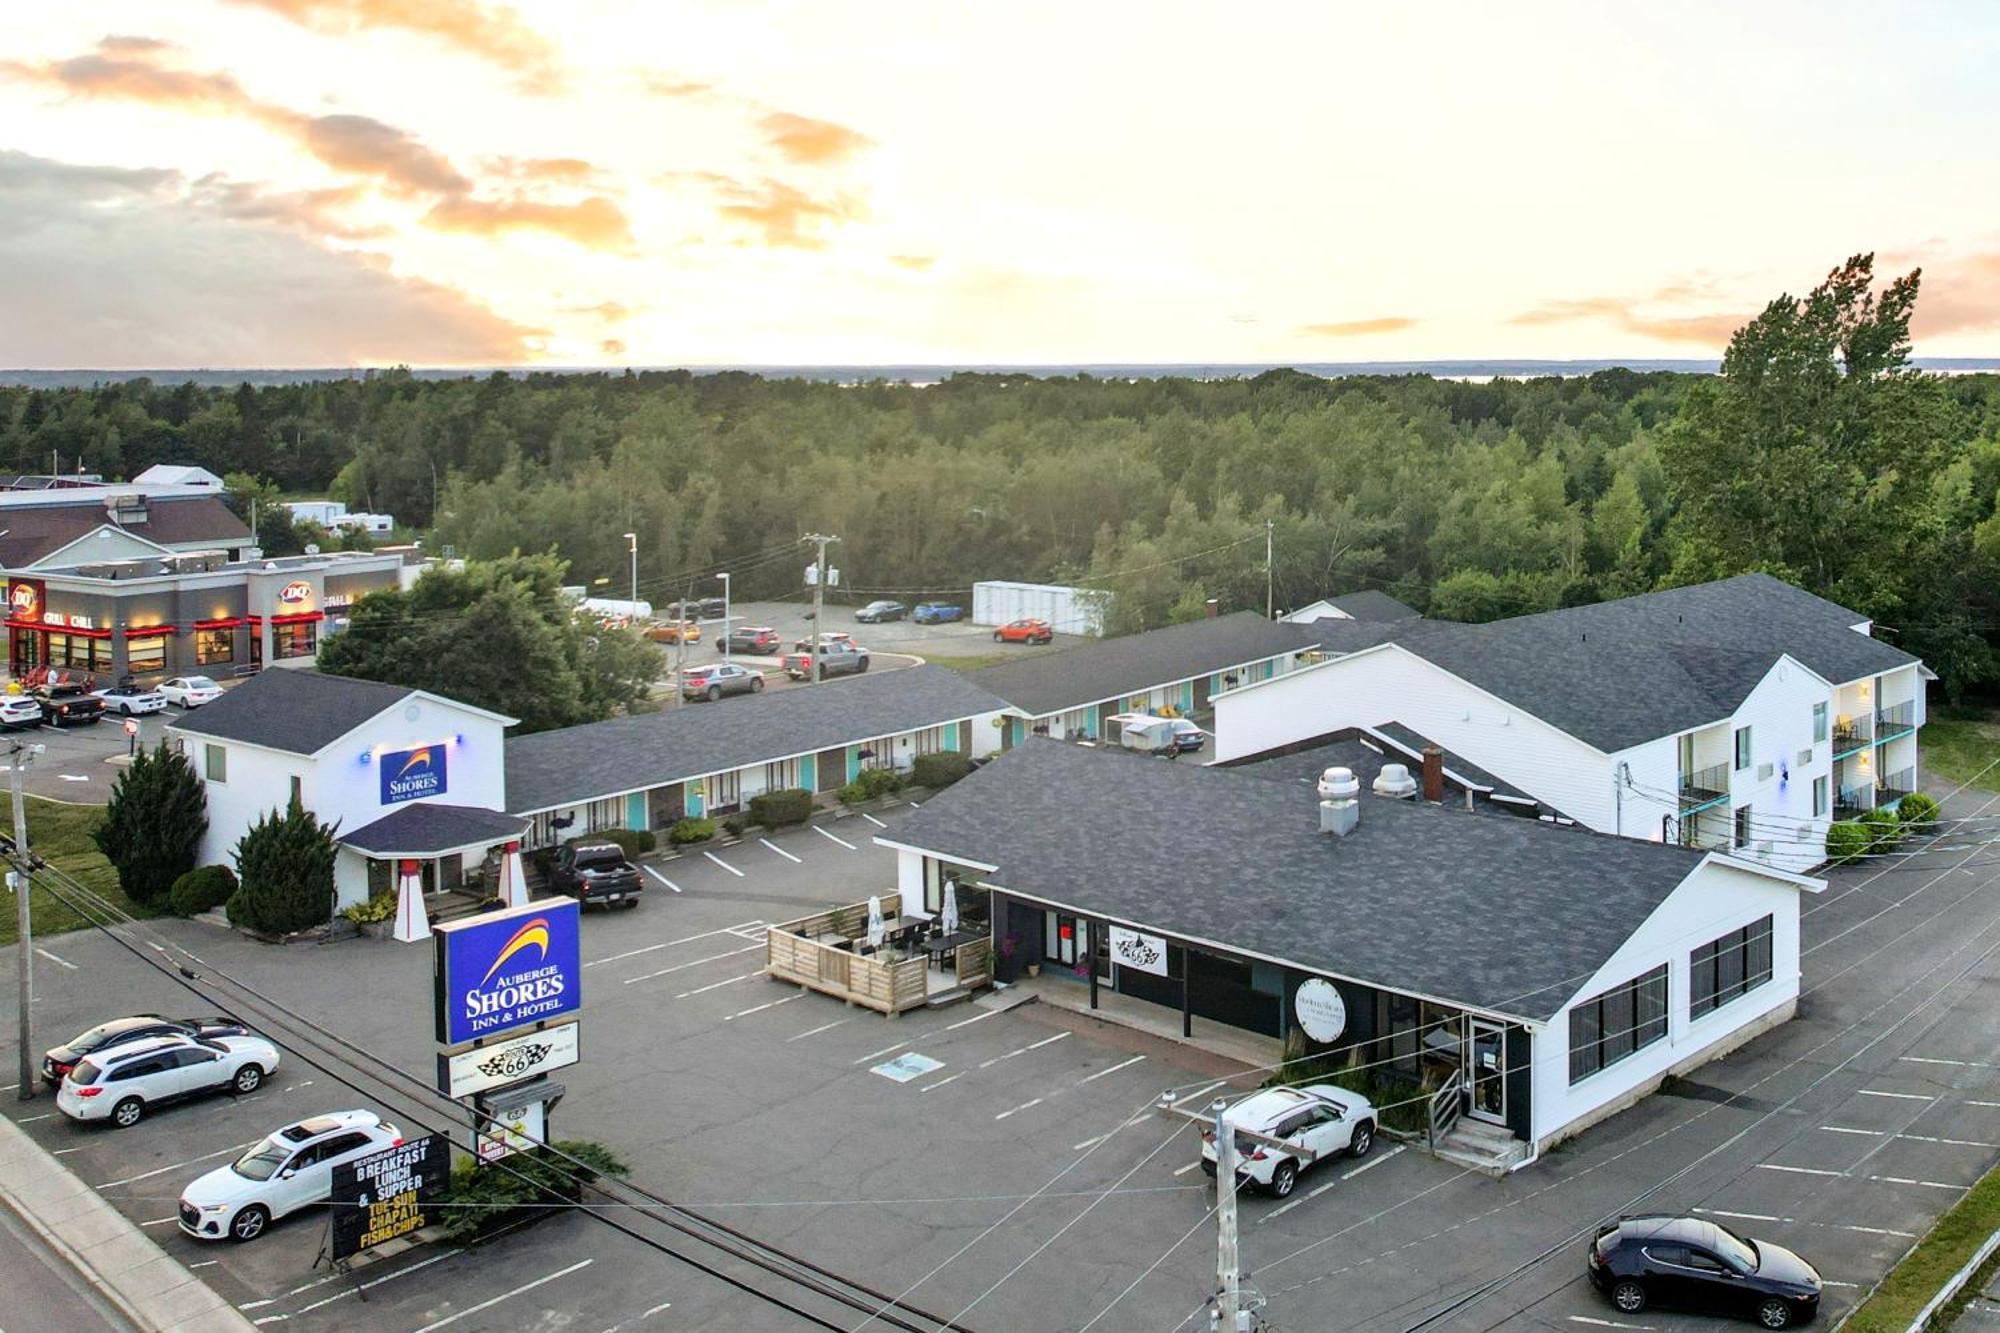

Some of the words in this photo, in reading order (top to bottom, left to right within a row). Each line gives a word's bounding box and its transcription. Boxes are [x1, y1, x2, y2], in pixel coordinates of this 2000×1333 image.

[390, 777, 438, 795] SHORES
[496, 965, 558, 989] AUBERGE
[466, 974, 564, 1018] SHORES
[472, 1016, 499, 1031] INN
[502, 1012, 513, 1022] &
[517, 999, 563, 1018] HOTEL
[506, 1058, 525, 1074] 66
[357, 1147, 426, 1181] BREAKFAST
[375, 1165, 411, 1189] LUNCH
[359, 1193, 368, 1207] &
[377, 1175, 422, 1200] SUPPER
[360, 1214, 425, 1248] FISH&CHIPS
[369, 1203, 418, 1231] CHAPATI
